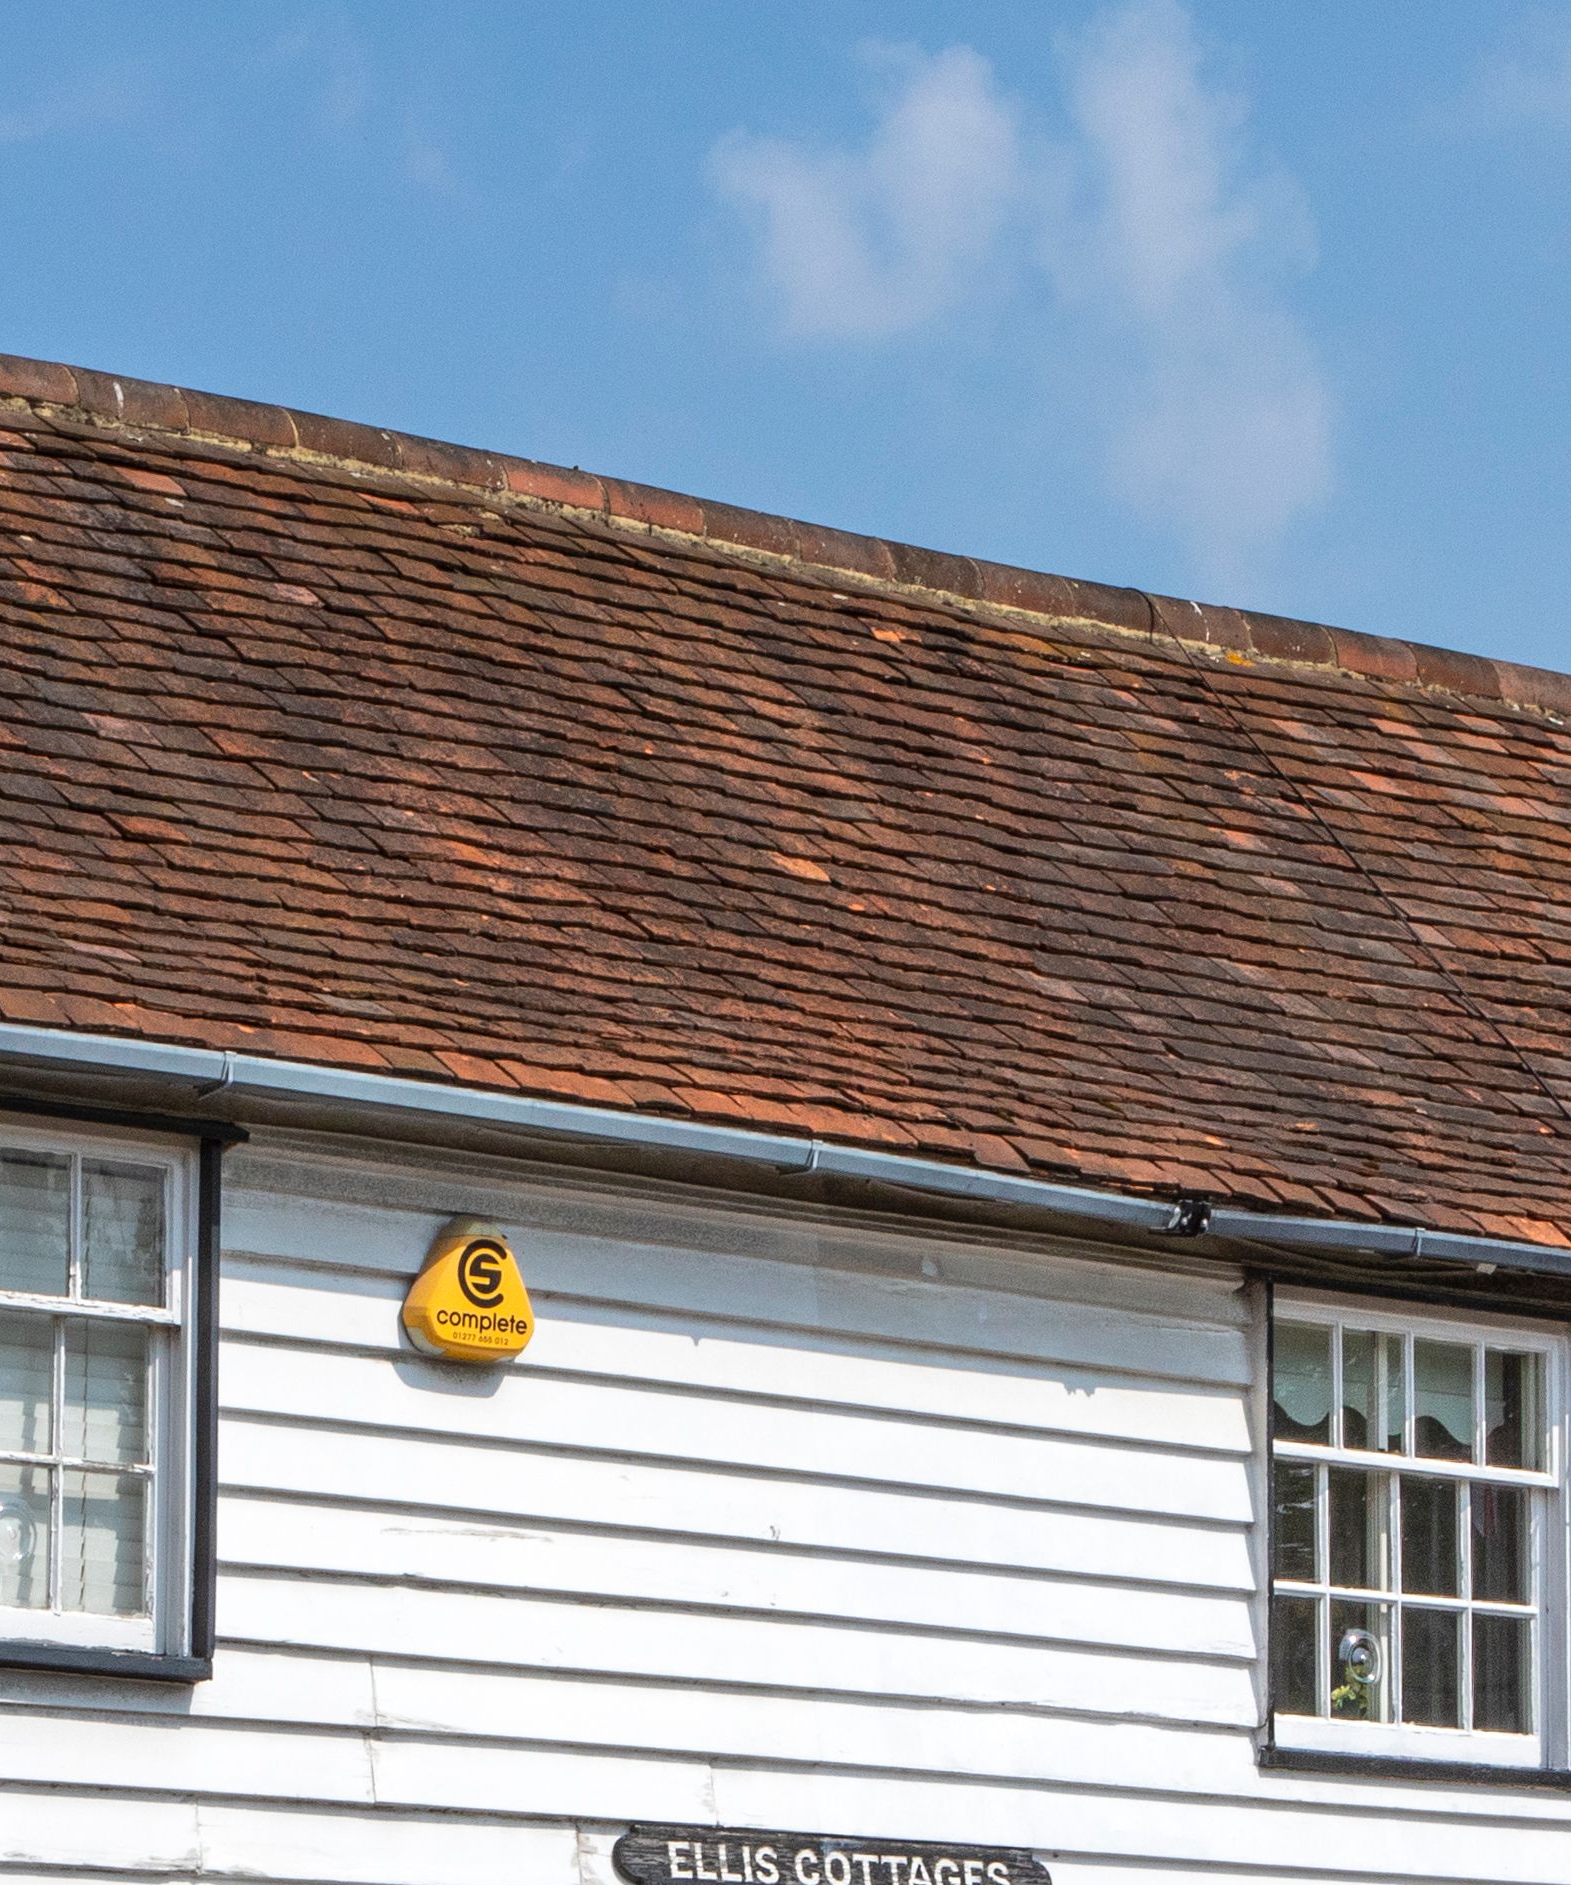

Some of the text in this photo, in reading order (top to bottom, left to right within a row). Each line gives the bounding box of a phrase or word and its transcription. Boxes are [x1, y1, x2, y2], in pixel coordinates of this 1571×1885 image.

[437, 1309, 527, 1335] complete
[452, 1331, 476, 1341] 01277
[494, 1337, 509, 1346] 012
[666, 1840, 780, 1885] ELLIS
